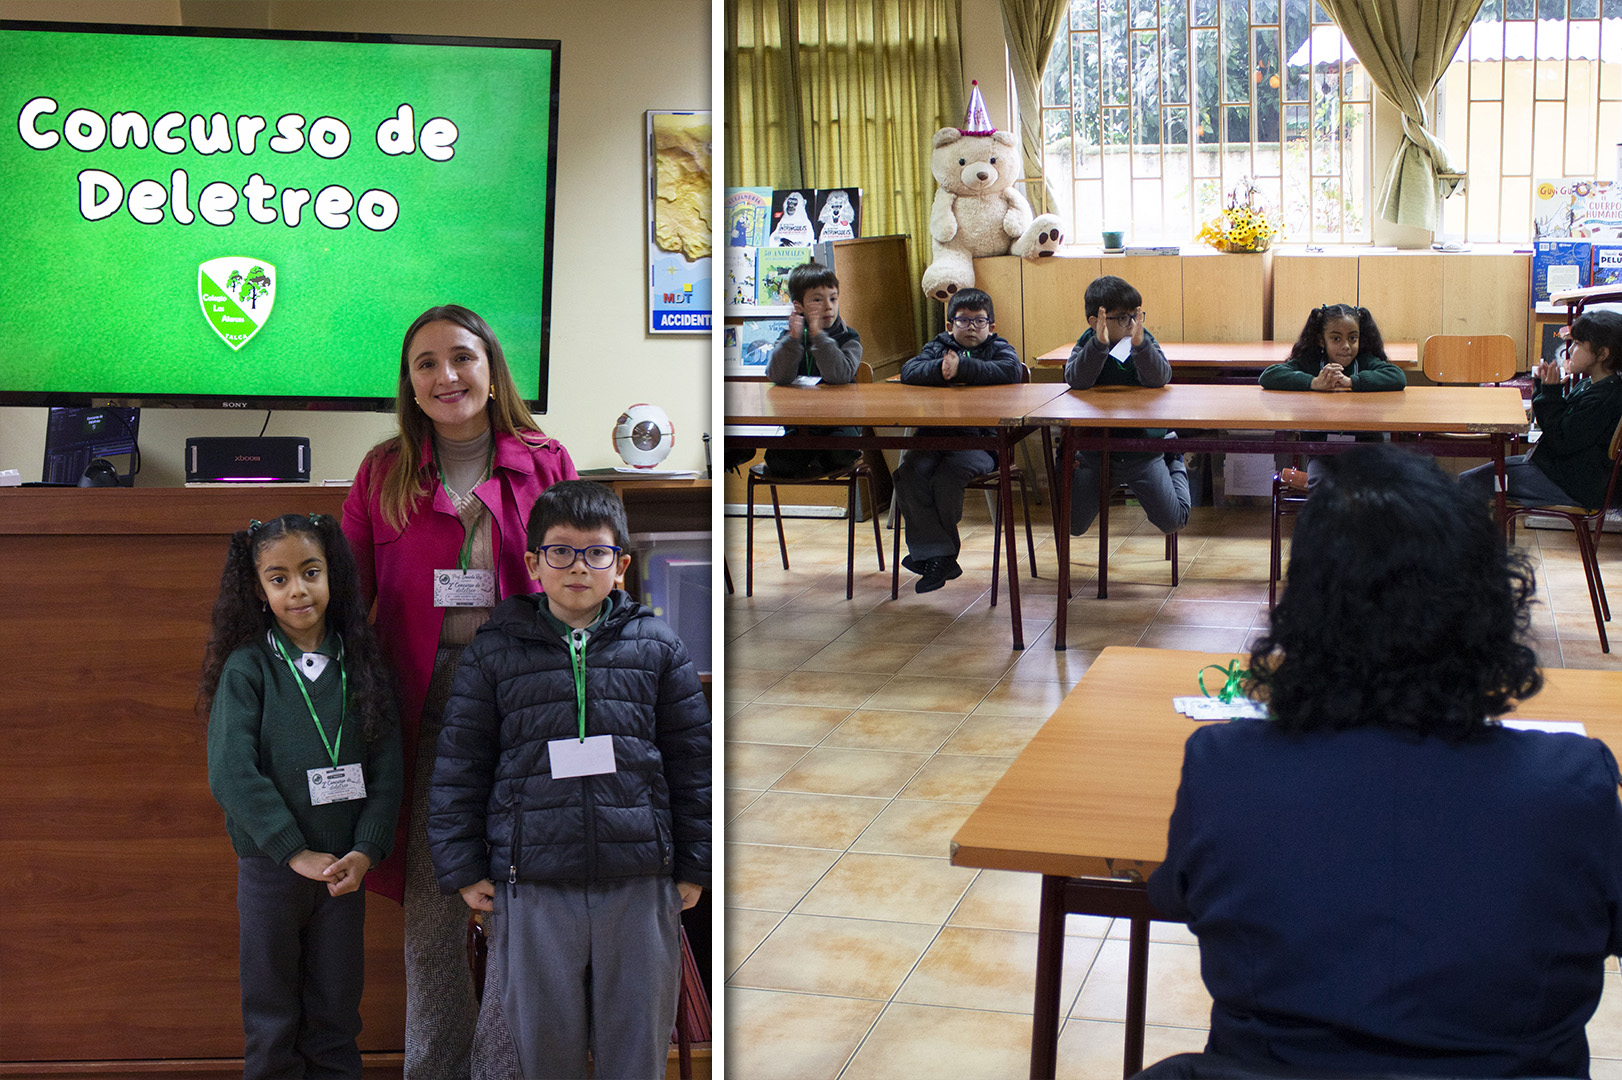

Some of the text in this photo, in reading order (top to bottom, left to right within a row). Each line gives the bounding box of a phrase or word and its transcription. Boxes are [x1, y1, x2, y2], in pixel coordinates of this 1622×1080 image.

[18, 96, 460, 161] Concurso de
[1540, 186, 1558, 198] Guyi
[77, 168, 399, 232] Deletreo
[1589, 202, 1622, 210] CUERPO
[663, 293, 693, 304] MDT
[661, 314, 712, 326] ACCIDENT
